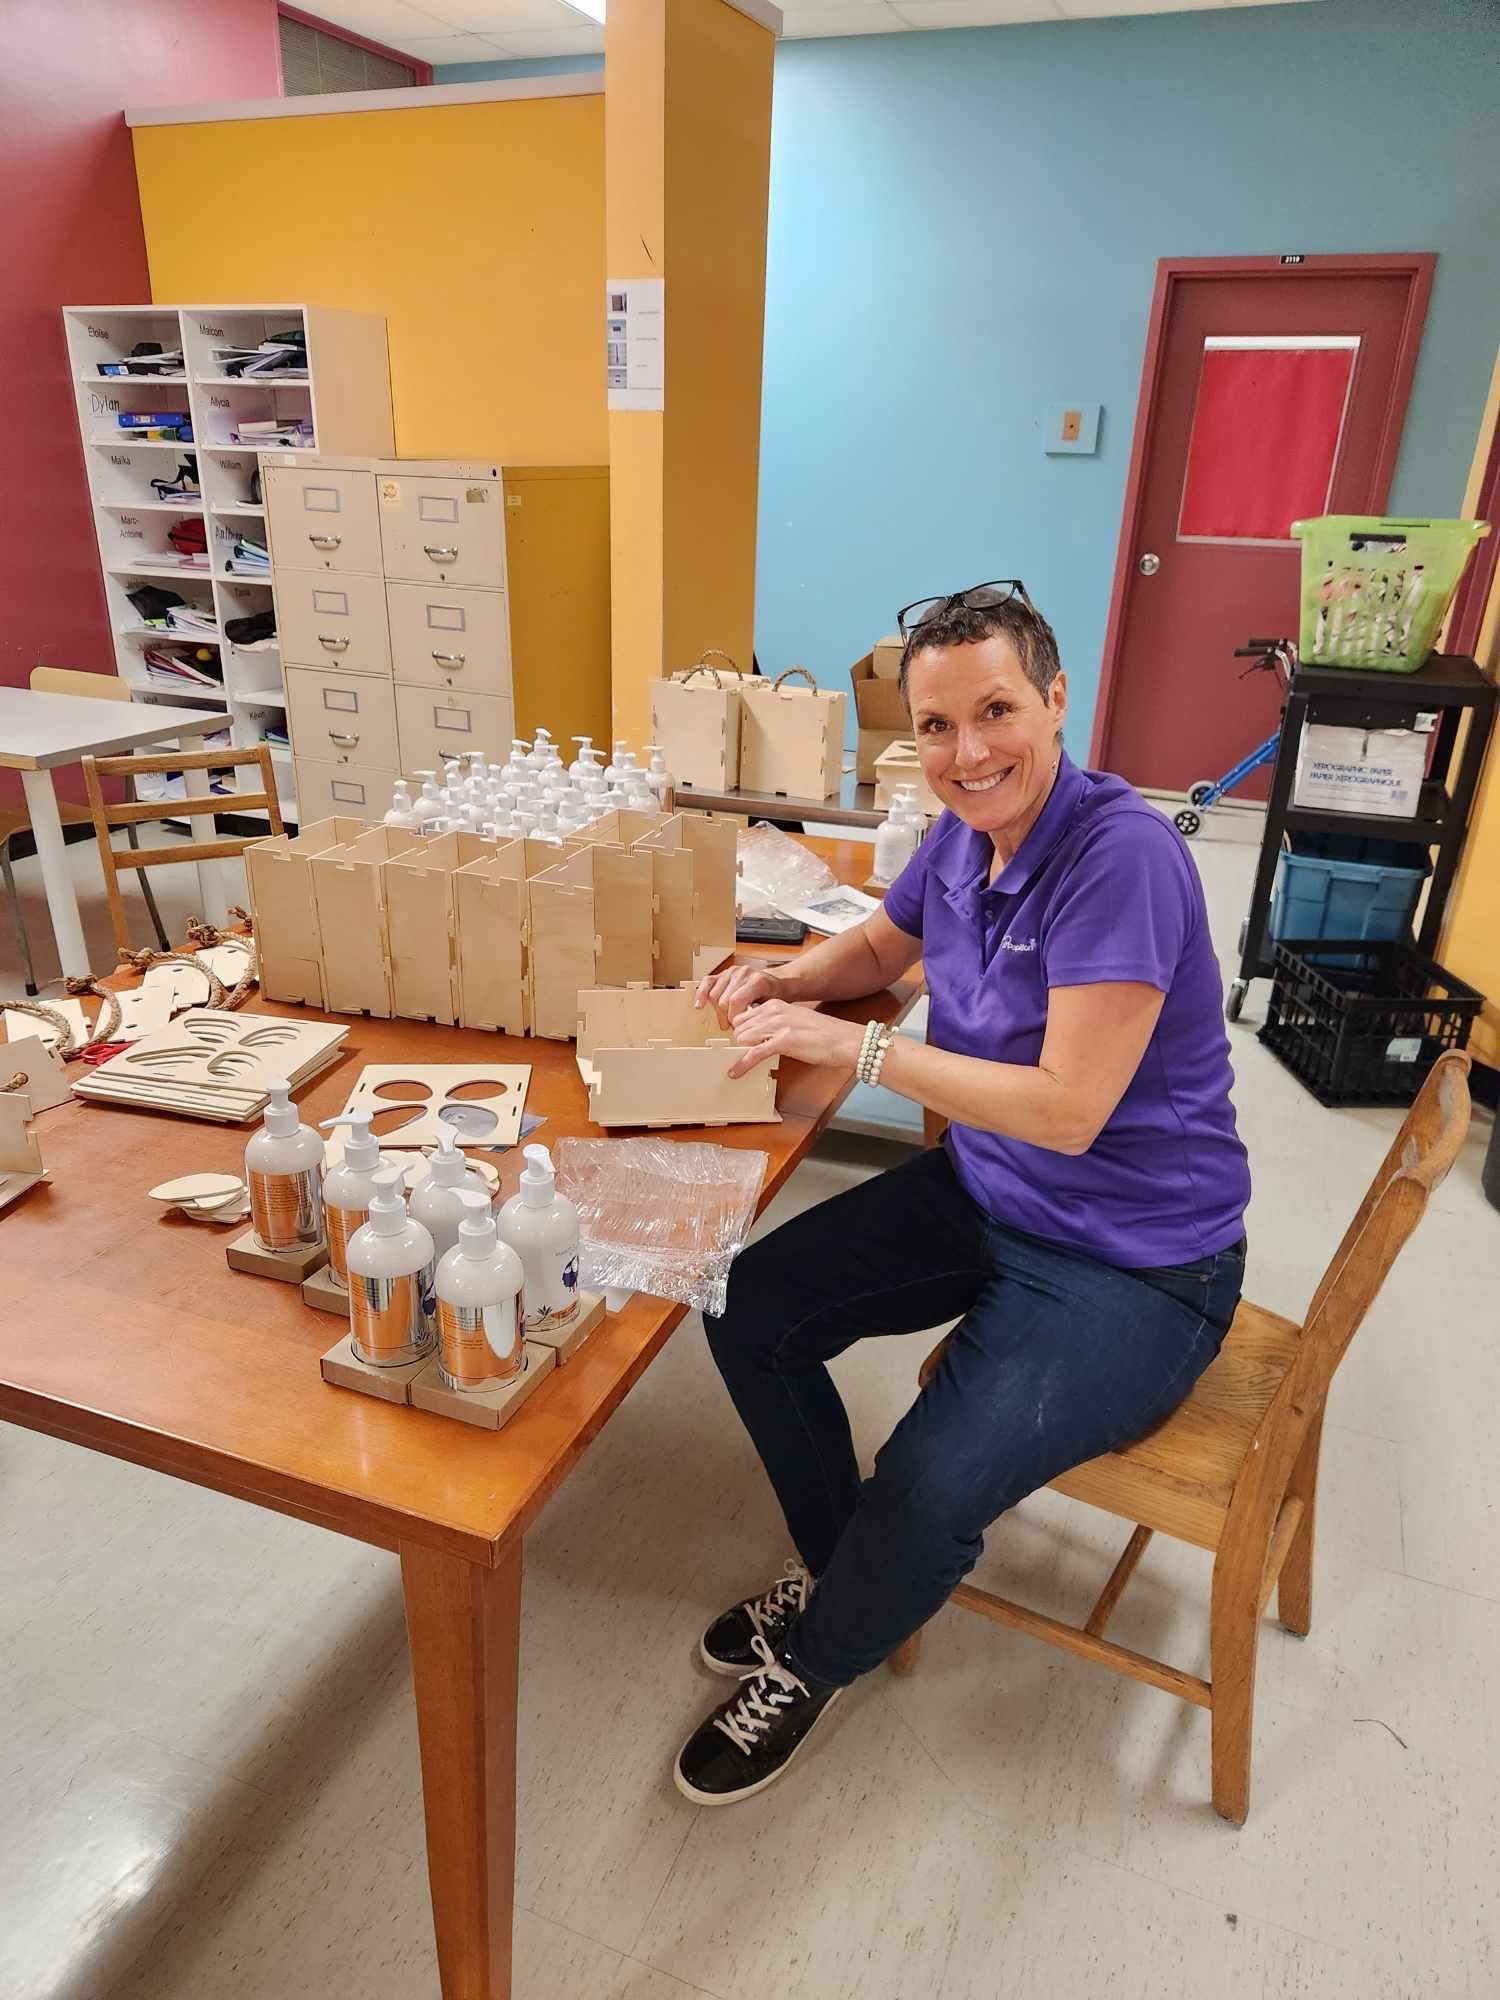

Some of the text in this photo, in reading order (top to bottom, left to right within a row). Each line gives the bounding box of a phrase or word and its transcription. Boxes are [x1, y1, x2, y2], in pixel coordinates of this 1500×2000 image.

[91, 393, 121, 413] Dylan
[1312, 761, 1393, 776] XEROGRAPHIC PAPER
